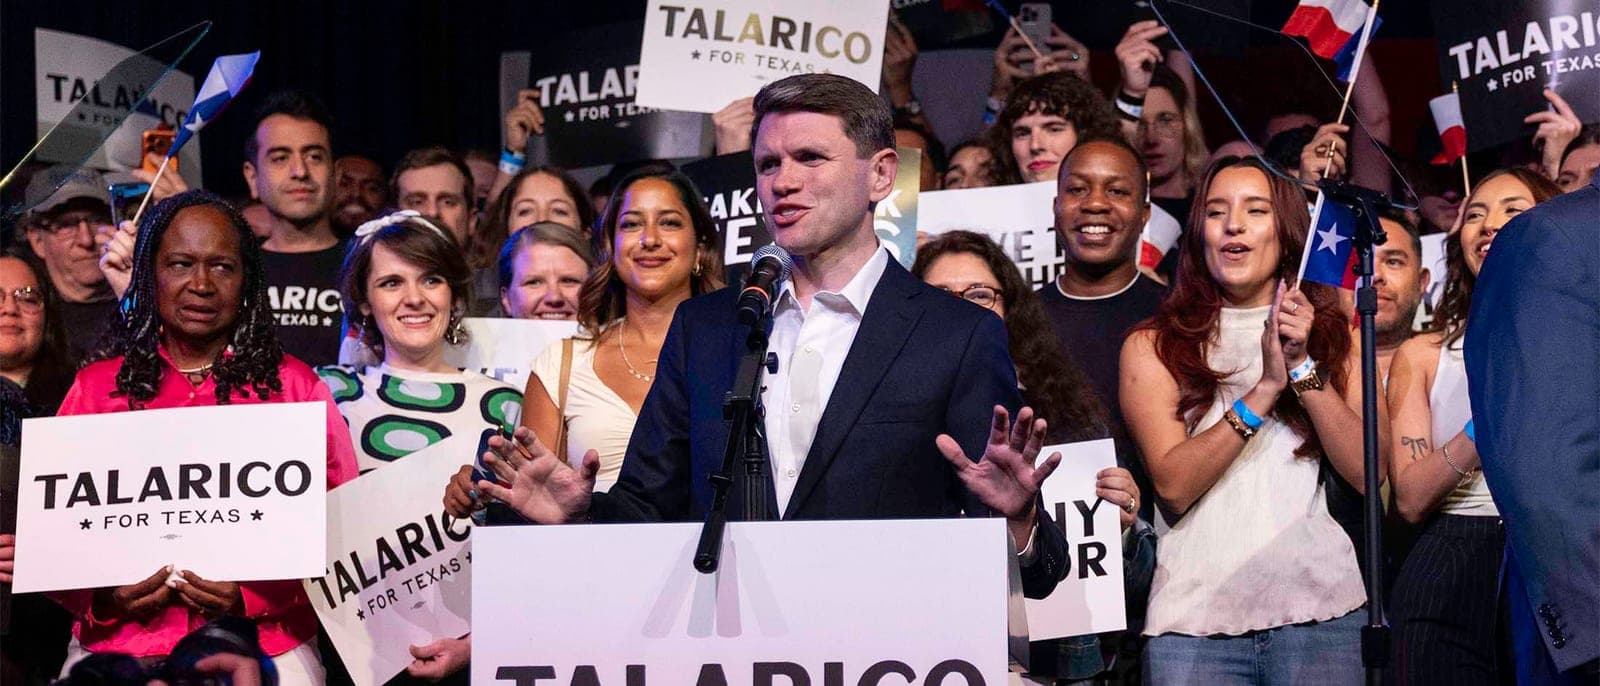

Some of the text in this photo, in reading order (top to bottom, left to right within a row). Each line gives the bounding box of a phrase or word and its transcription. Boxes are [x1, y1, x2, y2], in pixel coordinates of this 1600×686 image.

[659, 5, 872, 64] TALARICO
[1449, 12, 1600, 79] TALARI
[709, 50, 815, 74] FOR TEXAS
[1502, 65, 1536, 88] FOR
[579, 105, 610, 121] FOR
[267, 286, 345, 313] ARIC
[34, 460, 312, 510] TALARICO
[104, 509, 241, 529] FOR TEXAS
[367, 558, 461, 615] FOR TEXAS
